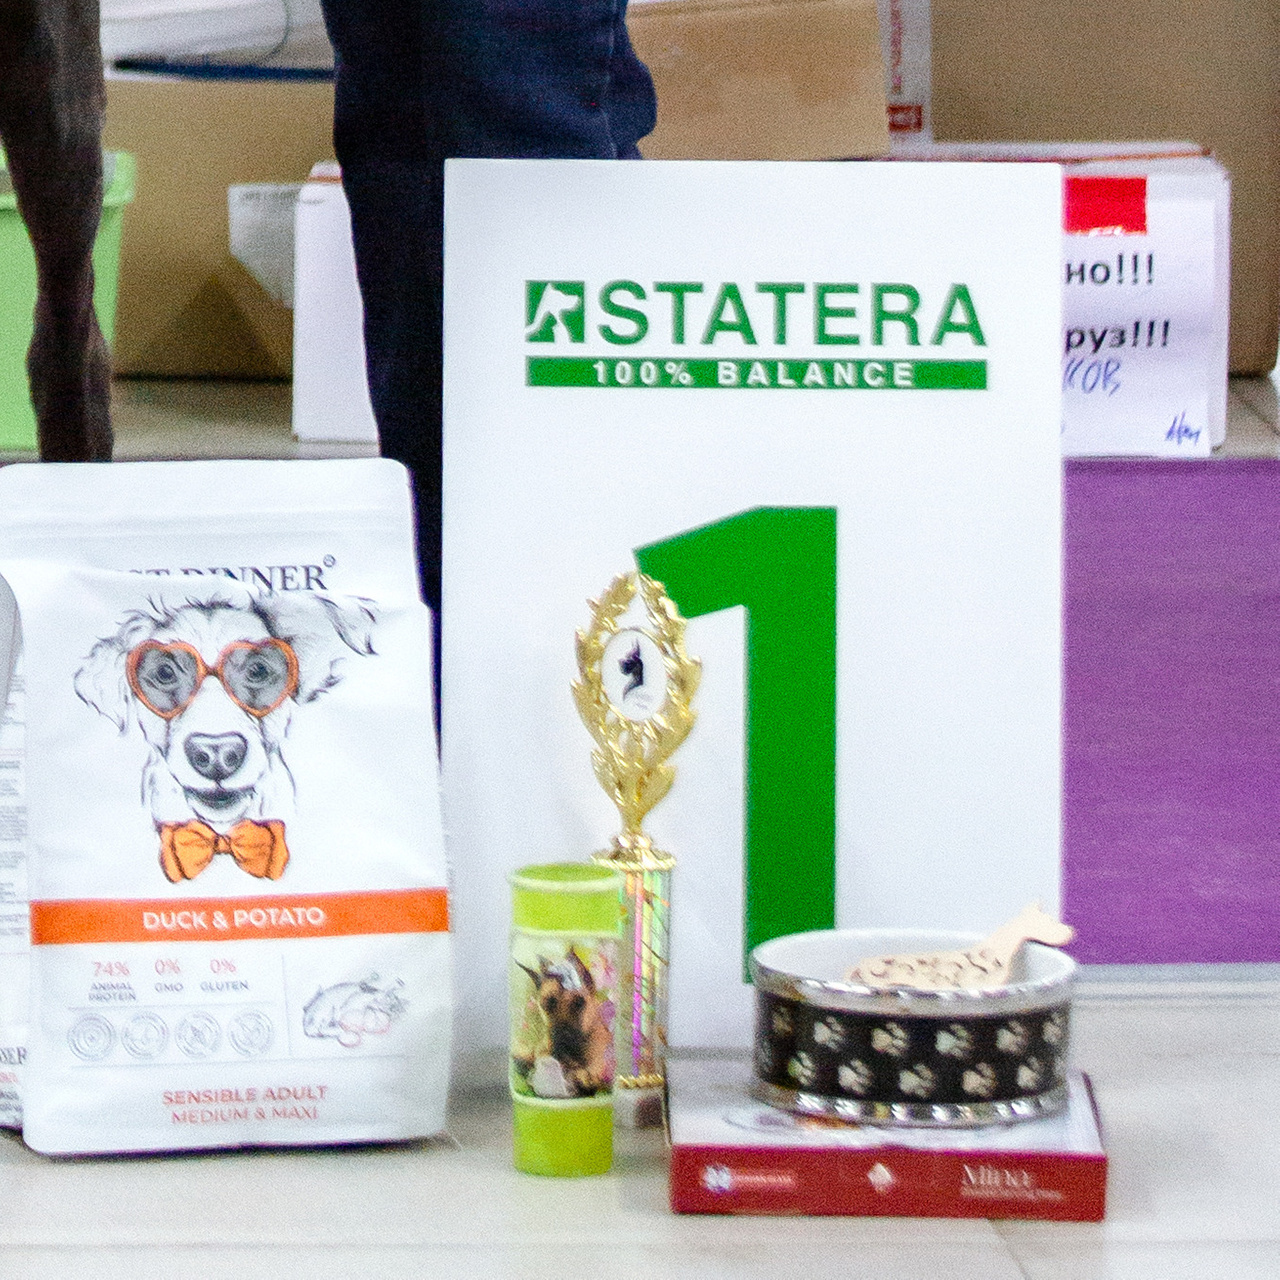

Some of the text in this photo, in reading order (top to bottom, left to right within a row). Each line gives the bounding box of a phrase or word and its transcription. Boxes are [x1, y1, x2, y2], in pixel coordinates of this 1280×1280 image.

[598, 278, 988, 346] STATERA
[593, 361, 915, 387] 100% BALANCE
[634, 506, 837, 983] 1
[143, 906, 326, 930] DUCK & POTATO
[154, 958, 182, 975] 0%
[209, 958, 237, 974] 0%
[90, 979, 250, 993] ANIMAL GMO GLUTEN
[162, 1084, 329, 1106] SENSIBLE ADULT
[172, 1104, 319, 1125] MEDIUM & MAXI
